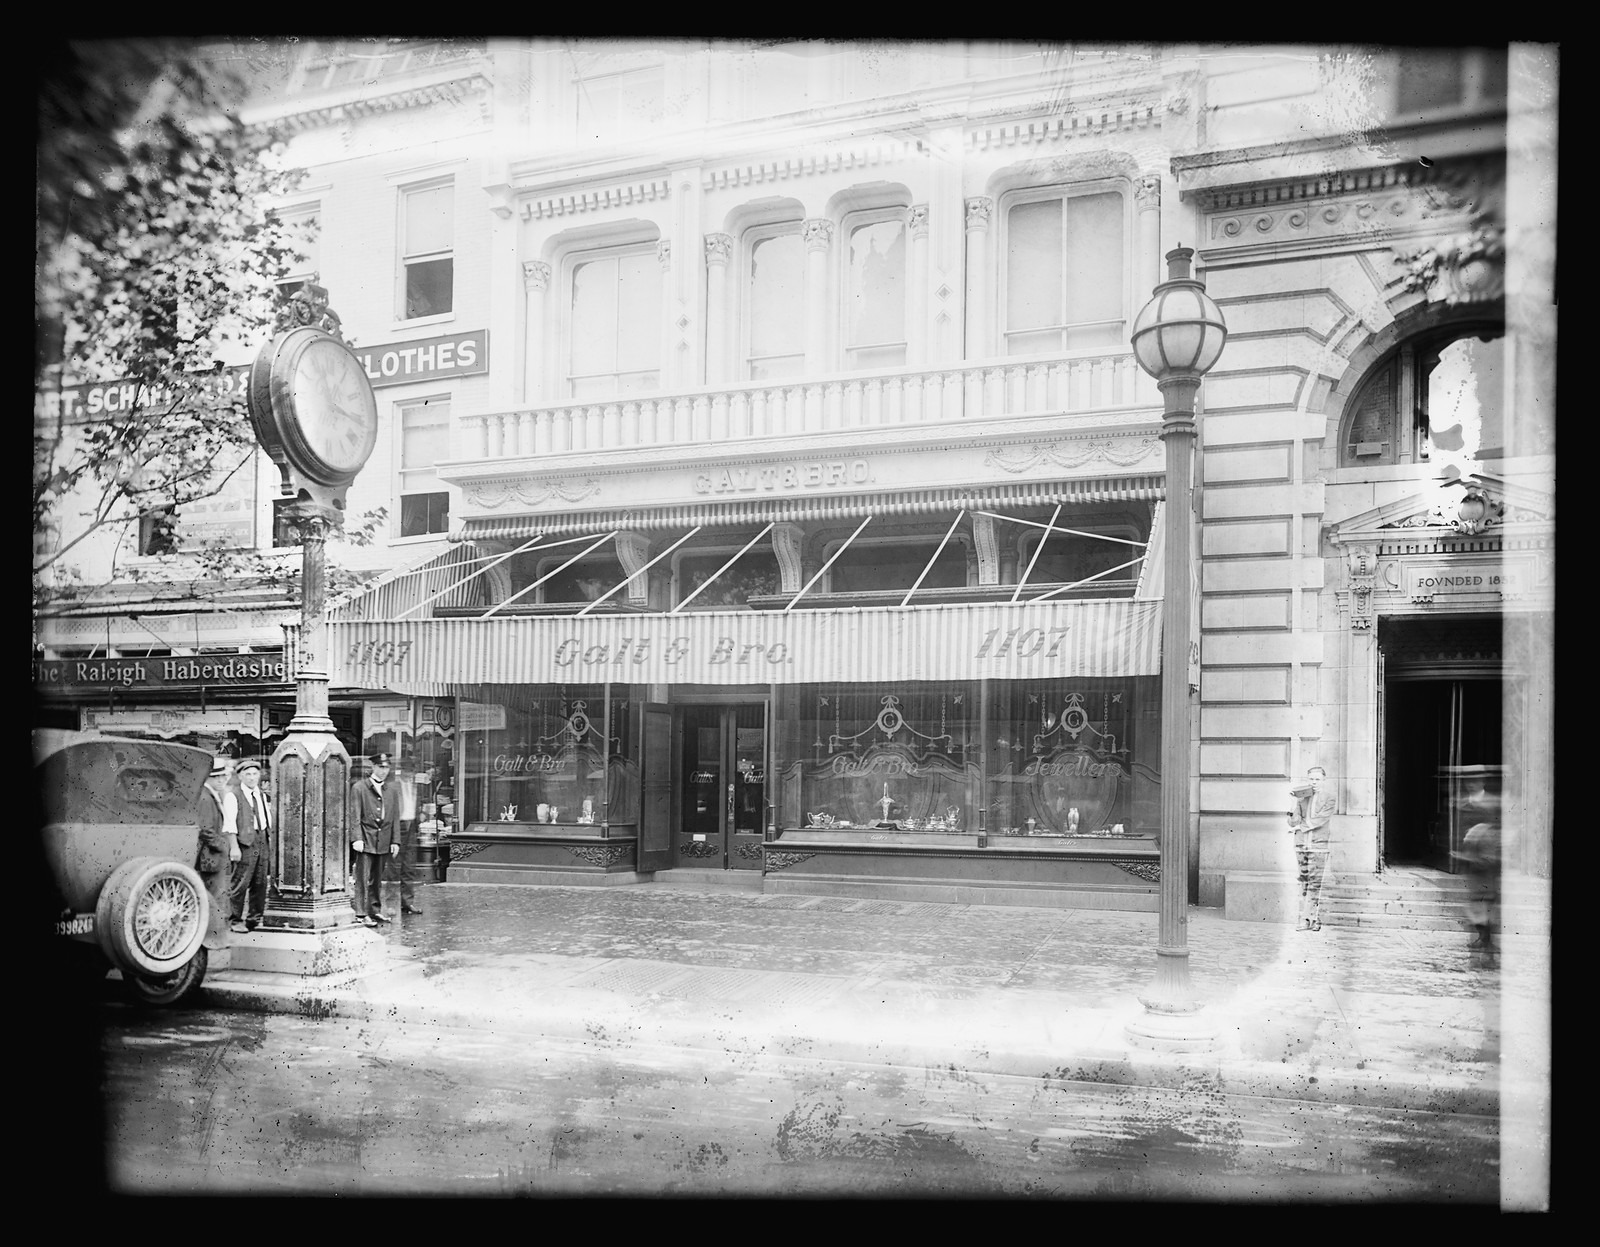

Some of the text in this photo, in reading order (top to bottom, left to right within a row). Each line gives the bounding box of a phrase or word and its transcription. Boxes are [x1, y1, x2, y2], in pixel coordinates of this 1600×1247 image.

[358, 340, 476, 379] LOTHES
[696, 466, 779, 494] GALT
[804, 459, 876, 487] BRO.
[1418, 575, 1482, 588] FOVNDED
[345, 640, 413, 666] 1107
[554, 637, 793, 667] Galt & Bro.
[974, 626, 1071, 659] 1107
[76, 662, 147, 686] Raleigh
[494, 754, 523, 772] Galt
[1025, 755, 1122, 777] Jewellers
